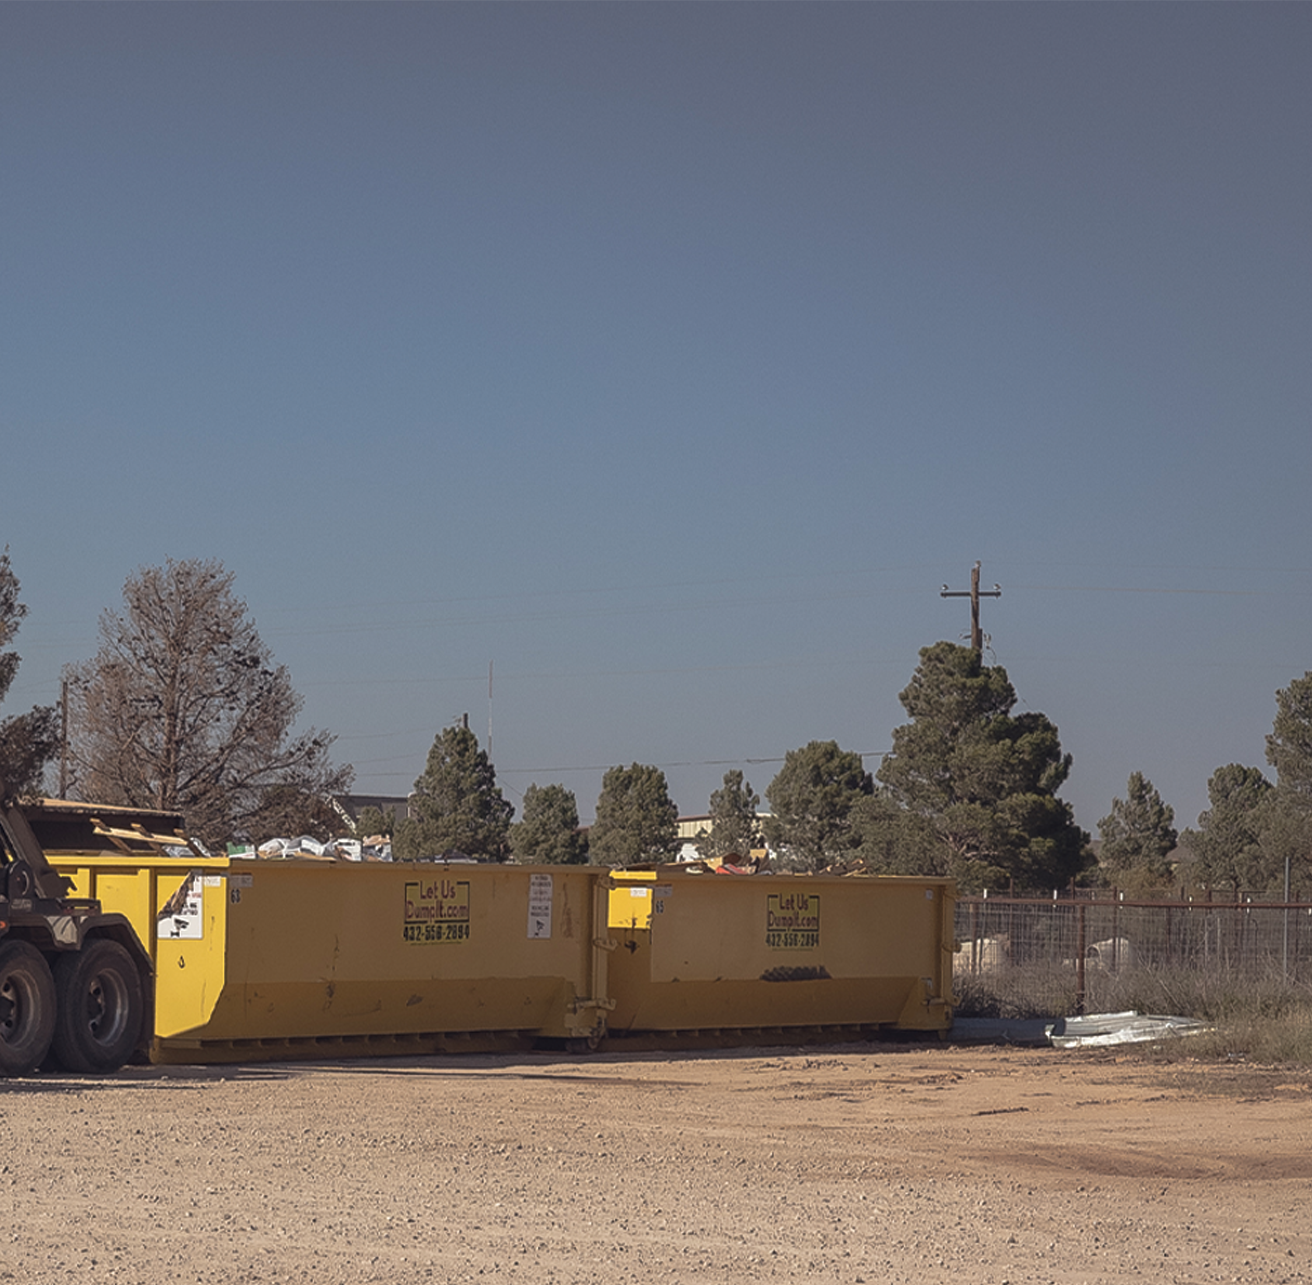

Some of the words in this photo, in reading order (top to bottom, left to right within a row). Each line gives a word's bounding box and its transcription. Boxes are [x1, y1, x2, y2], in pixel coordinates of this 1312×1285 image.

[420, 881, 438, 899] Let
[441, 880, 456, 899] Us
[779, 893, 795, 910] Let
[797, 893, 809, 911] Us
